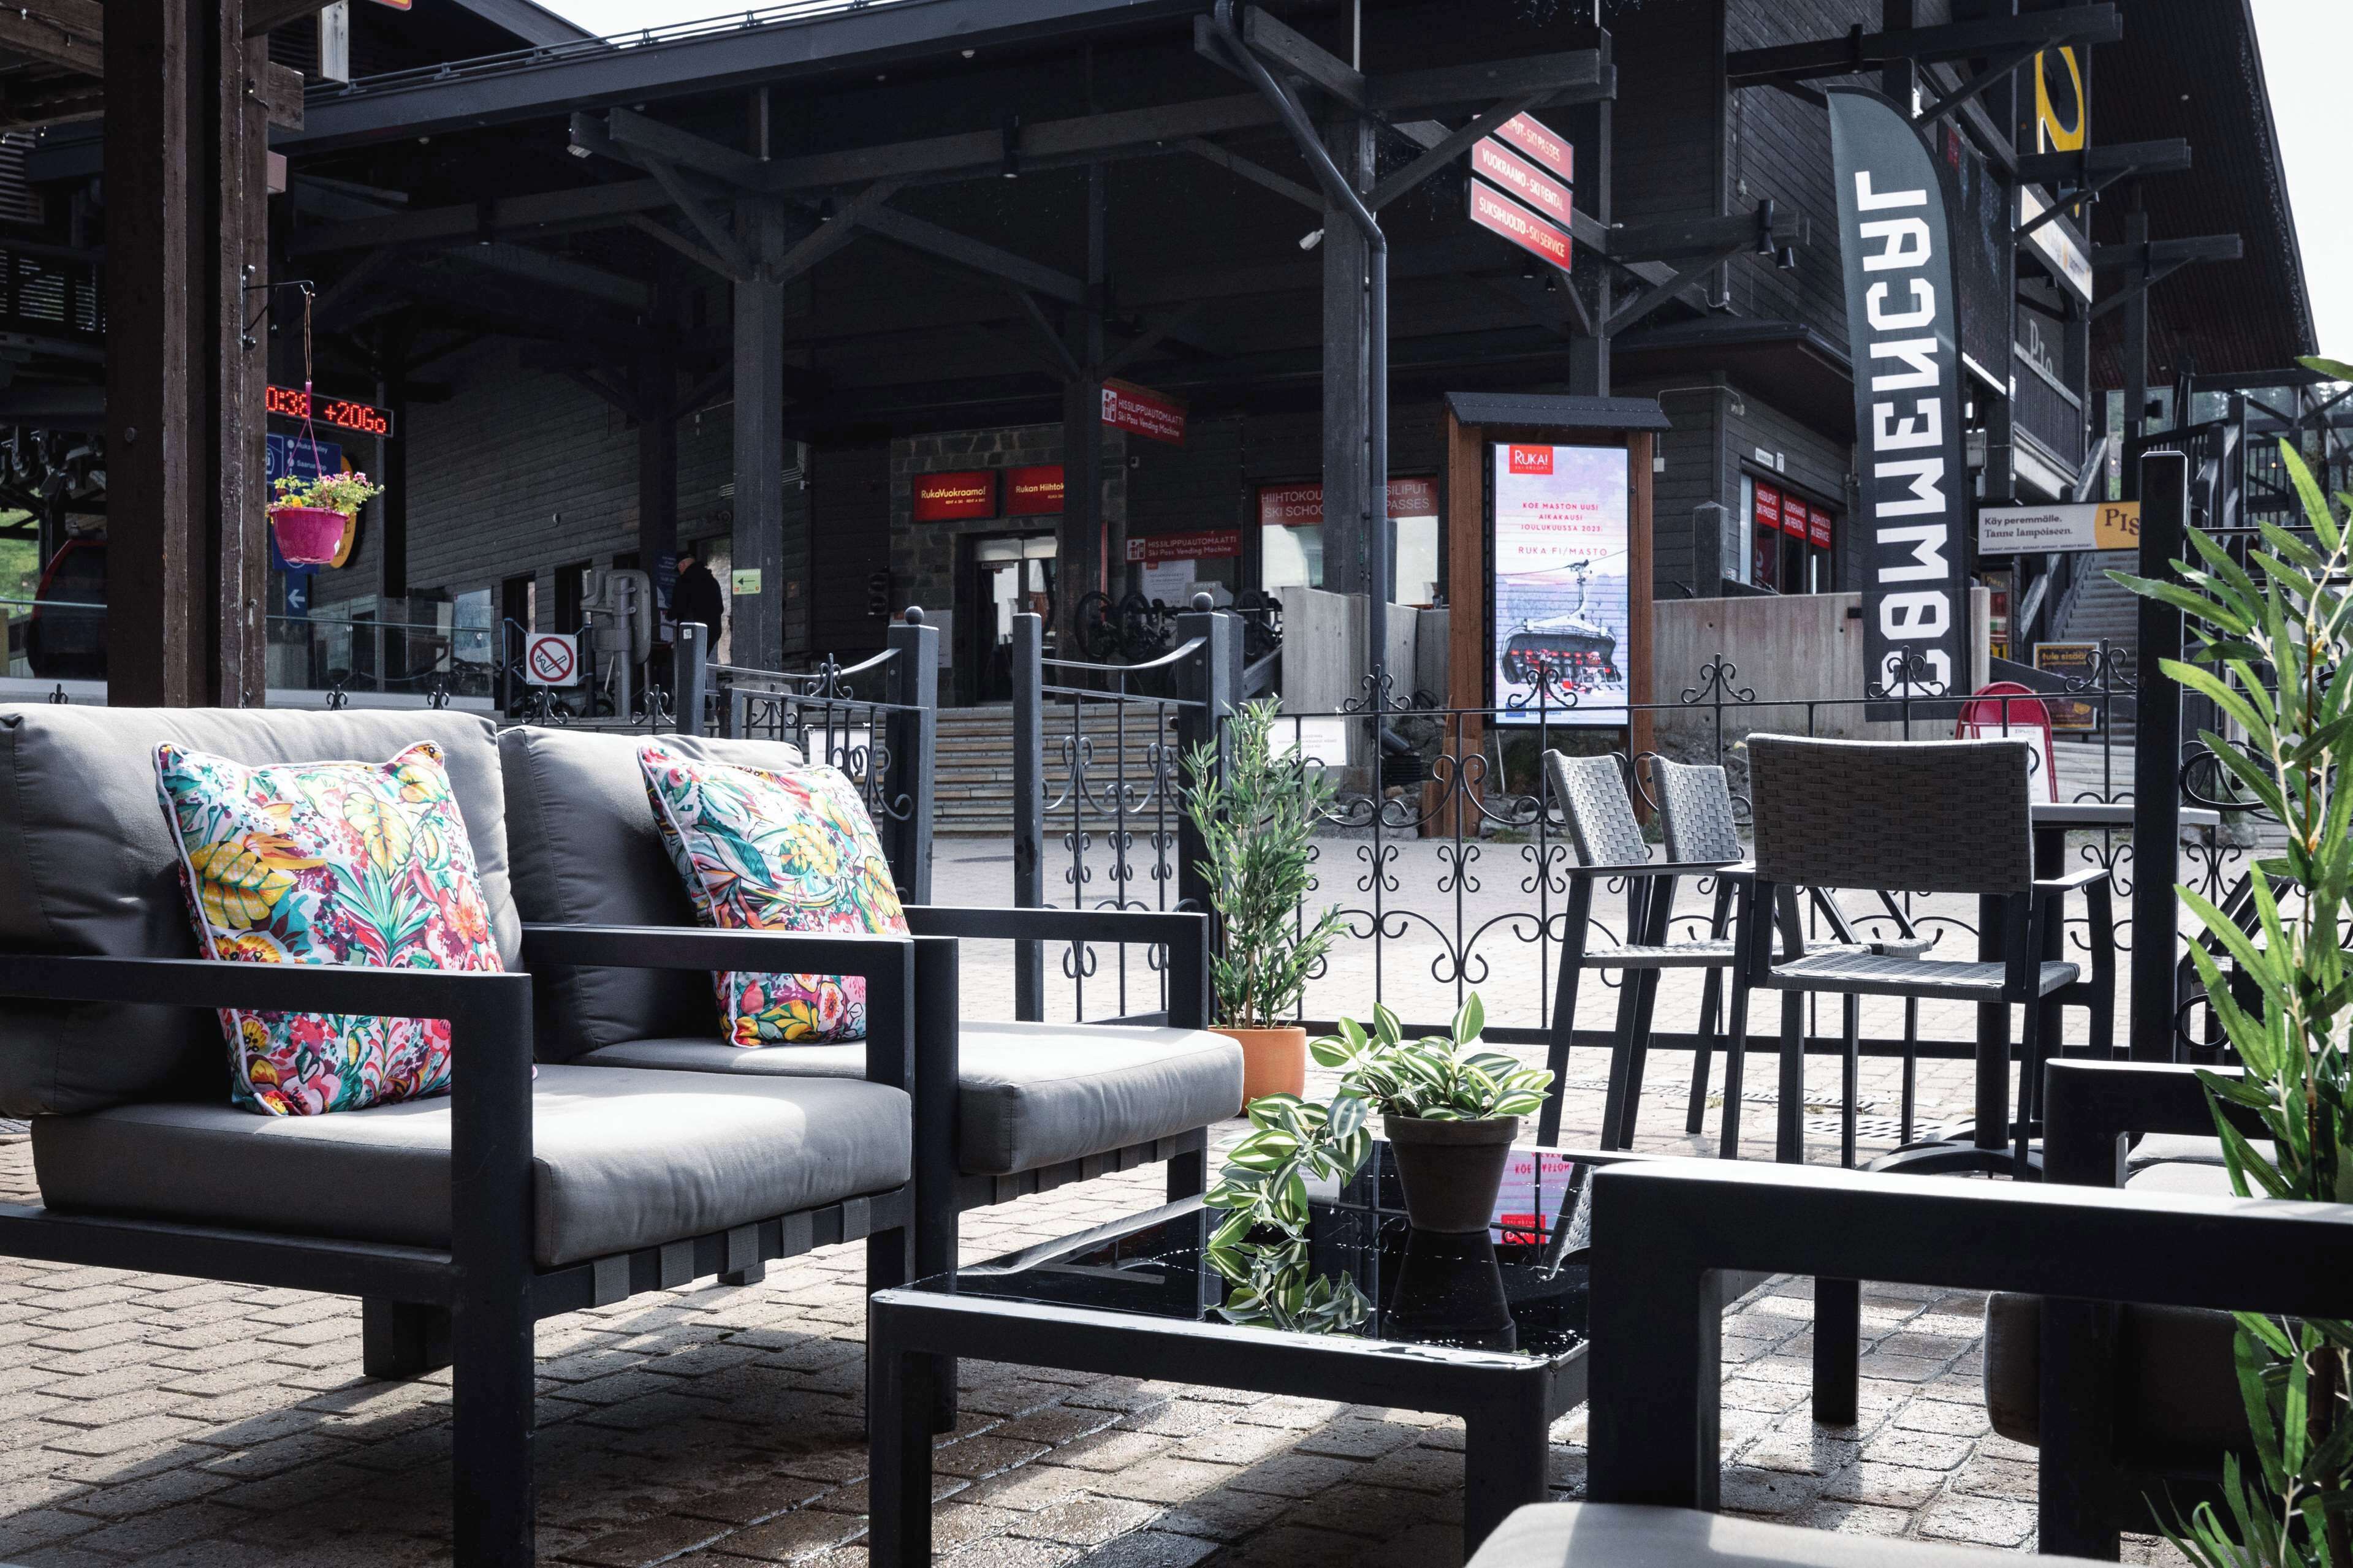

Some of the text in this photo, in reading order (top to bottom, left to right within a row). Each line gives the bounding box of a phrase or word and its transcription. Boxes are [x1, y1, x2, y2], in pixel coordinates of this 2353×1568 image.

[1527, 129, 1537, 146] SKI
[1537, 135, 1560, 162] PASSES
[1482, 148, 1526, 187] VUOKRAAMO
[1530, 178, 1540, 196] SKI
[1541, 185, 1564, 211] RENTAL
[1479, 197, 1526, 235] SUKSIHUOLTO
[1529, 226, 1540, 243] SKI
[1540, 232, 1565, 257] SERVICE
[1118, 398, 1184, 426] HISSILIPPUAUTOMAATTI
[1127, 414, 1138, 425] Pass
[1139, 417, 1158, 434] Vending
[1159, 423, 1180, 437] Machine
[1515, 450, 1548, 465] RUKA!
[921, 485, 986, 498] RukaVuokraamo!
[1016, 485, 1037, 493] Rukan
[1265, 507, 1282, 518] SKI
[1985, 515, 2062, 526] Käy peremmälle.
[1147, 536, 1237, 548] HISSILIPPUAUTOMAATTI
